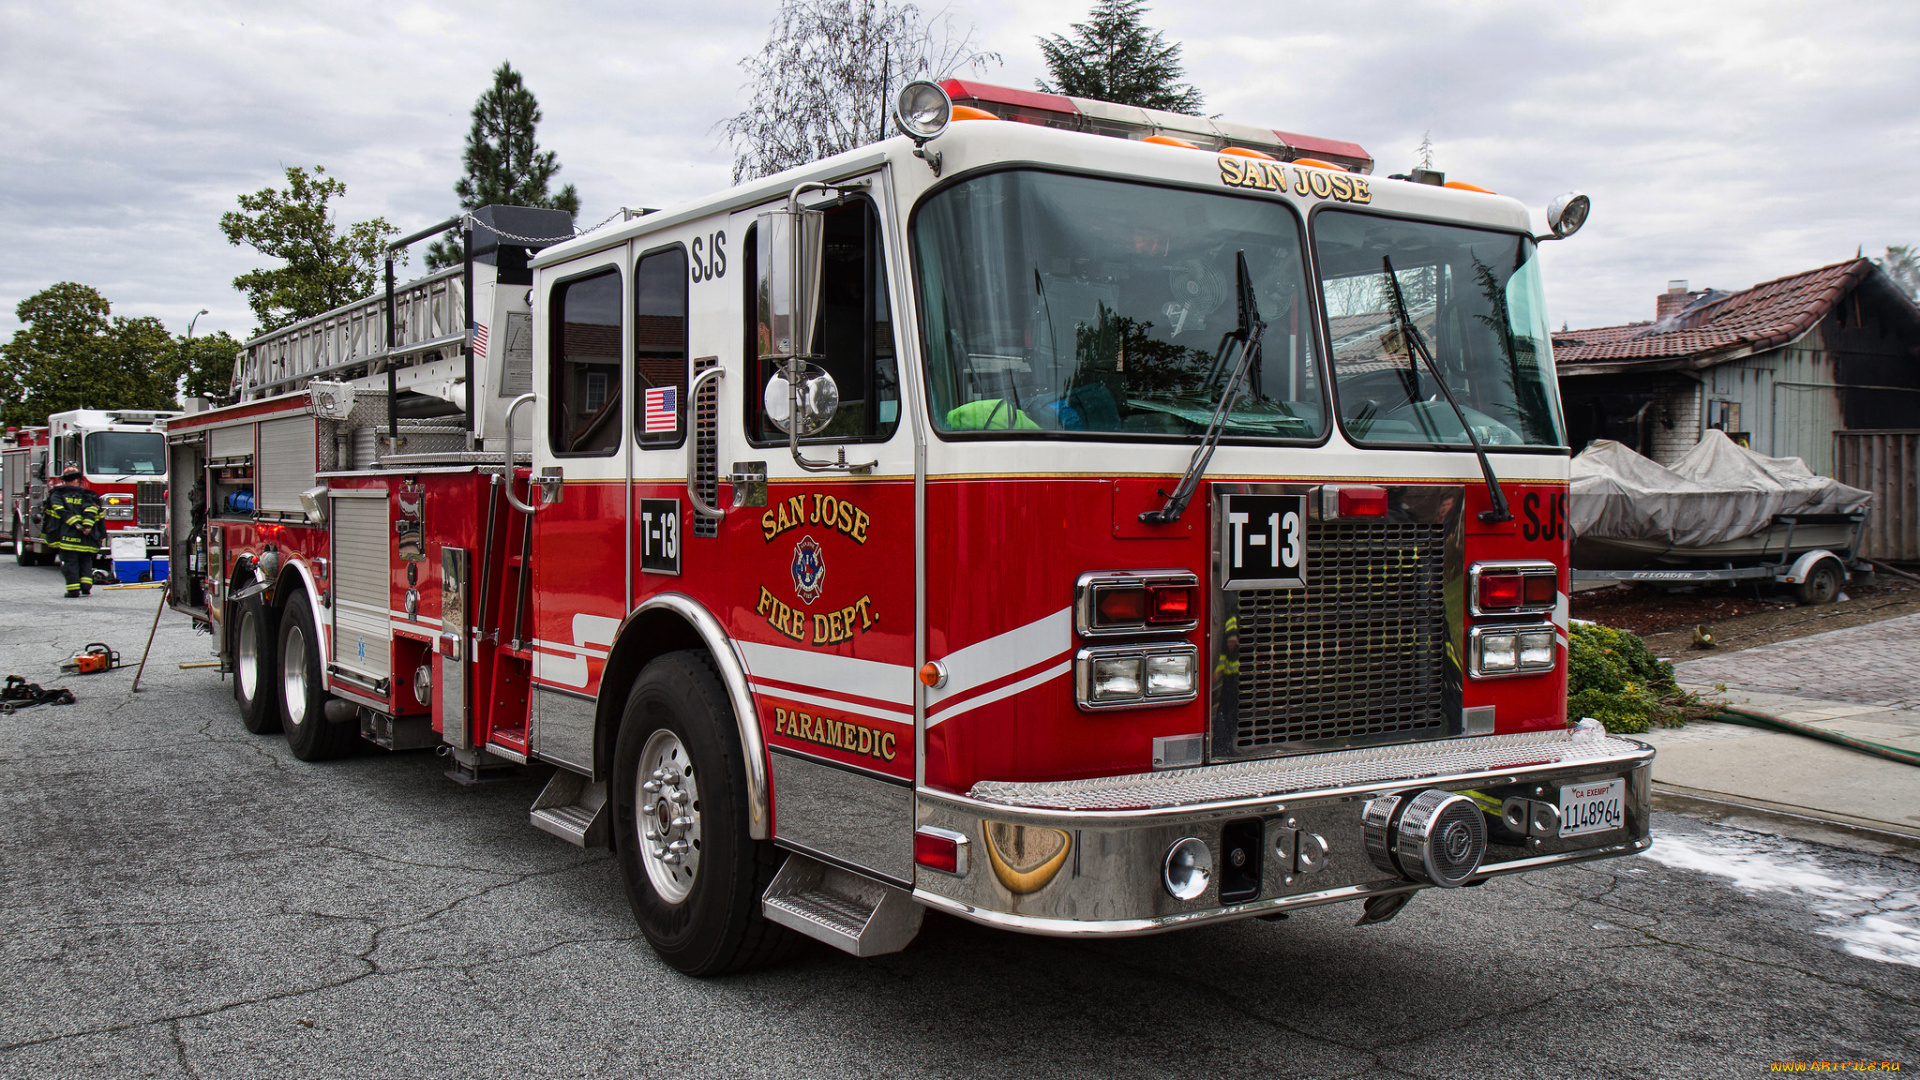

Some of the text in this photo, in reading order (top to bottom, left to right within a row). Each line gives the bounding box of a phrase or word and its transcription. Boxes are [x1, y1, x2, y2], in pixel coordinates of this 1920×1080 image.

[1218, 155, 1372, 204] SAN JOSE
[691, 230, 727, 284] SJS
[145, 534, 159, 545] E-9
[642, 512, 676, 559] T-13
[761, 492, 871, 545] SAN JOSE
[1229, 511, 1300, 568] T-13
[1522, 491, 1569, 542] SJS
[756, 584, 880, 646] FIRE DEPT.
[774, 706, 897, 763] PARAMEDIC
[1563, 798, 1620, 829] 1148964
[1586, 787, 1610, 797] EXEMPT
